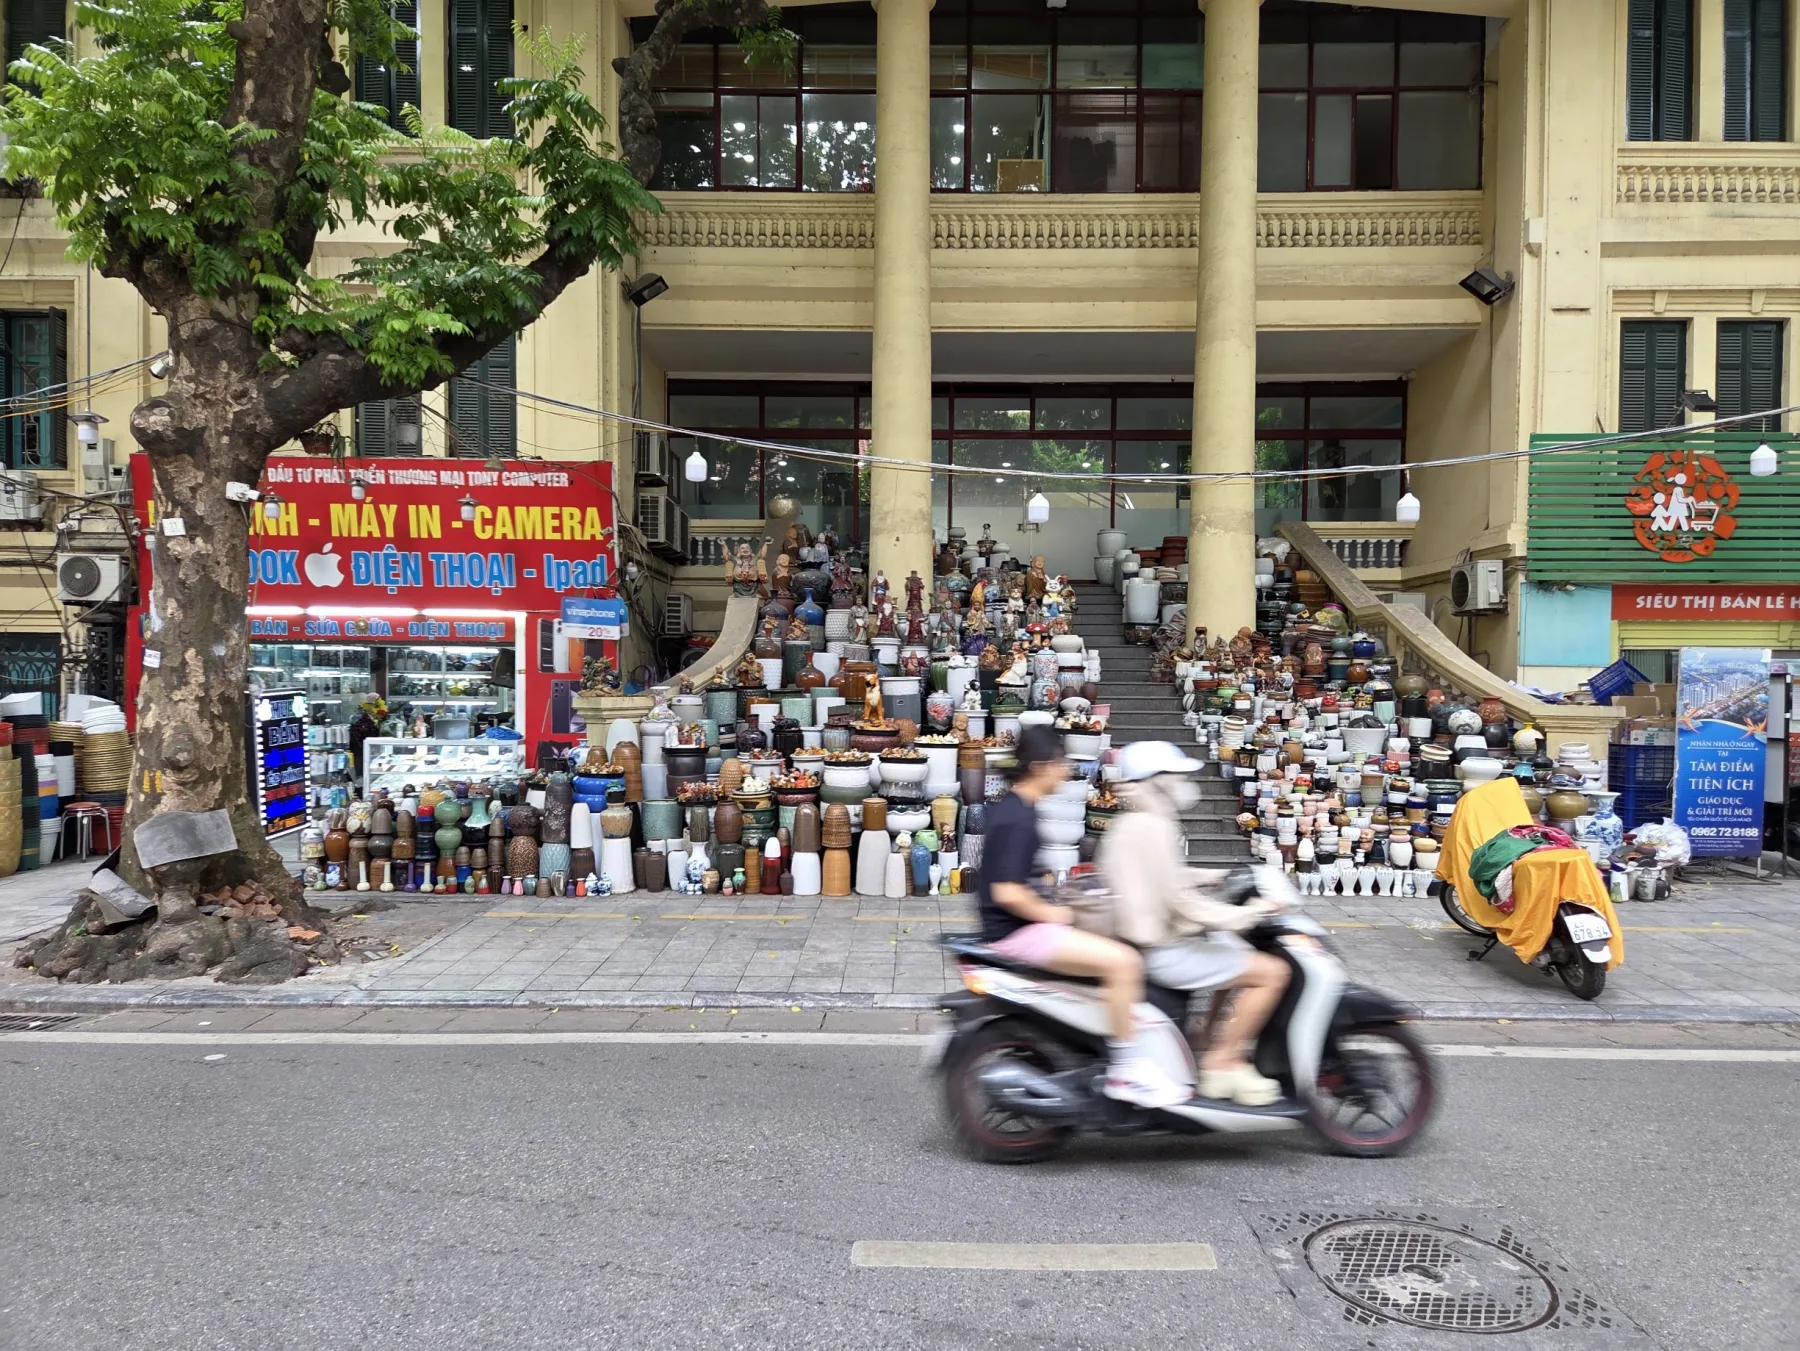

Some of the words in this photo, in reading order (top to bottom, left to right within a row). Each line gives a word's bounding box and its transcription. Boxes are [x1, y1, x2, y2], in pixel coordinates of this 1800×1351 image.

[267, 462, 293, 483] ĐẦU
[296, 467, 313, 483] TƯ
[315, 465, 346, 484] PHÁT
[349, 463, 386, 484] TRIỂN
[387, 468, 437, 485] THƯƠNG
[439, 470, 464, 489] MẠI
[467, 471, 499, 487] TONY
[501, 471, 569, 487] COMPUTER
[330, 497, 398, 538] MÁY
[408, 504, 442, 539] IN
[473, 505, 604, 540] CAMERA
[352, 543, 423, 595] ĐIỆN
[428, 552, 517, 596] THOẠI
[544, 553, 608, 593] Ipad
[1636, 593, 1677, 609] SIÊU
[1682, 595, 1715, 612] THỊ
[1720, 593, 1760, 609] BÁN
[565, 606, 616, 619] vinaphone
[251, 616, 288, 636] BÁN
[305, 615, 341, 636] SỬA
[345, 617, 392, 637] CỮA
[408, 618, 450, 640] ĐIỆN
[454, 622, 506, 641] THOẠI
[1689, 759, 1717, 772] TÂM
[1720, 757, 1754, 772] ĐIỂM
[1689, 776, 1722, 792] TIỆN
[1726, 776, 1754, 791] ÍCH
[1697, 795, 1721, 805] GIÁO
[1722, 796, 1743, 806] DỤC
[1695, 806, 1715, 815] GIẢI
[1717, 806, 1732, 815] TRÍ
[1733, 807, 1753, 816] MỚI
[1690, 827, 1717, 836] 0962
[1718, 827, 1731, 837] 72
